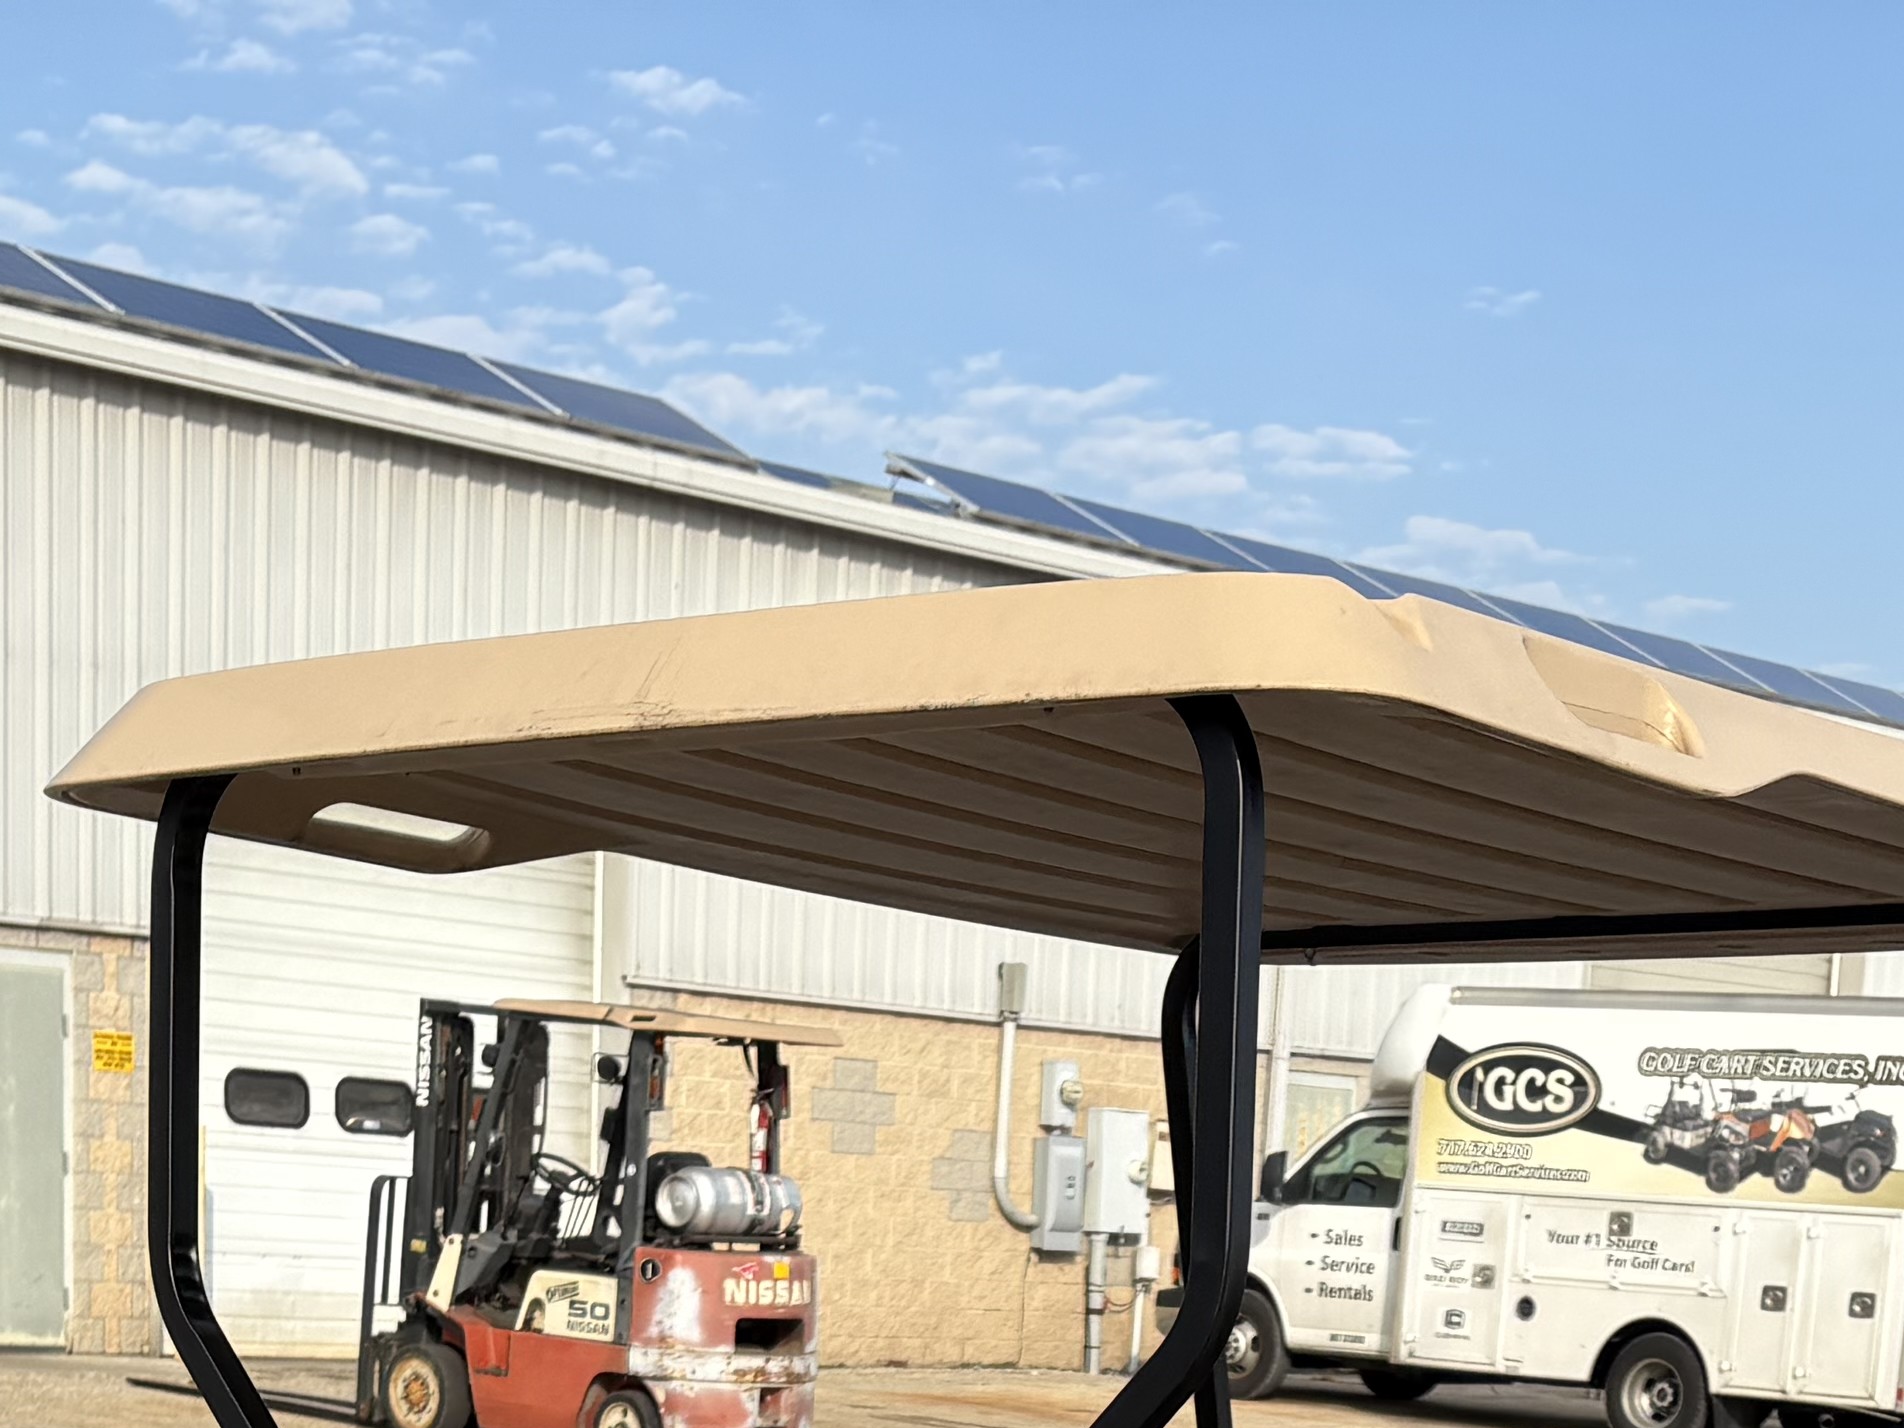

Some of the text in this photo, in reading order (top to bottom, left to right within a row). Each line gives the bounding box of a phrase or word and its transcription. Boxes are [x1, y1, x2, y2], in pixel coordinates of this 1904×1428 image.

[416, 1015, 433, 1107] NISSAN
[1640, 1051, 1699, 1073] GOLF
[1701, 1053, 1758, 1077] CART
[1759, 1056, 1869, 1082] SERVICES,
[1484, 1066, 1575, 1114] GCS
[1323, 1229, 1364, 1247] Sales
[1606, 1236, 1658, 1251] Source
[1320, 1255, 1375, 1275] Service
[1631, 1256, 1659, 1271] Golf
[1318, 1281, 1374, 1302] Rentals
[568, 1300, 610, 1321] 50
[566, 1319, 610, 1336] NISSAN
